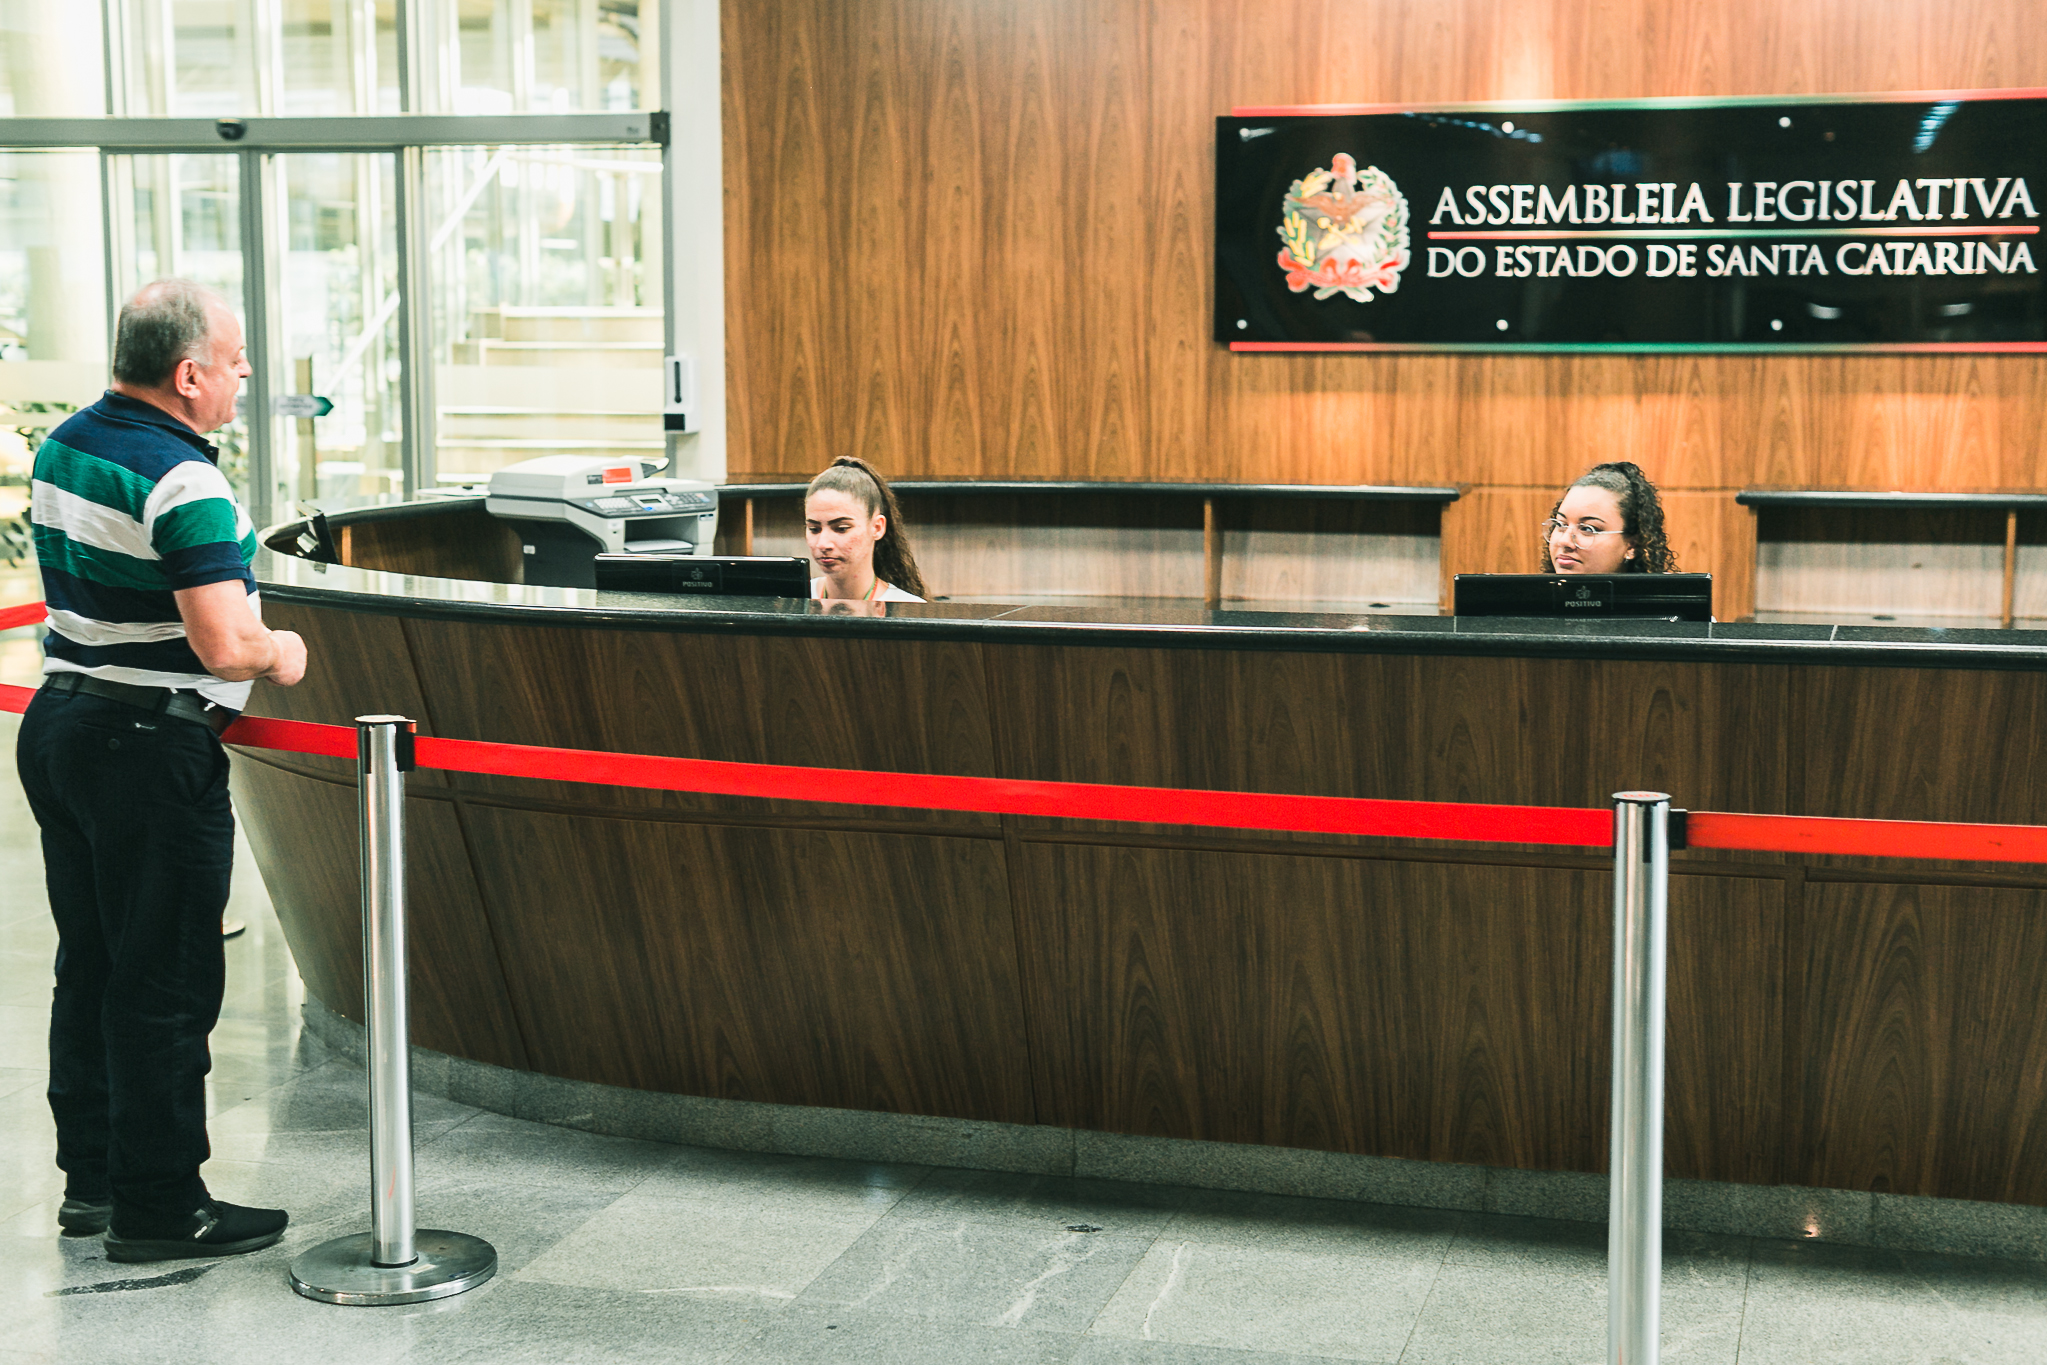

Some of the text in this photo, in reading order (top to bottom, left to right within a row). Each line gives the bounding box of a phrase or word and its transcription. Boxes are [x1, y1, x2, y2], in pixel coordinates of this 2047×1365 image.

[1429, 177, 2040, 226] ASSEMBLEIA LEGISLATIVA
[1427, 241, 2039, 278] DO ESTADO DE SANTA CATARINA
